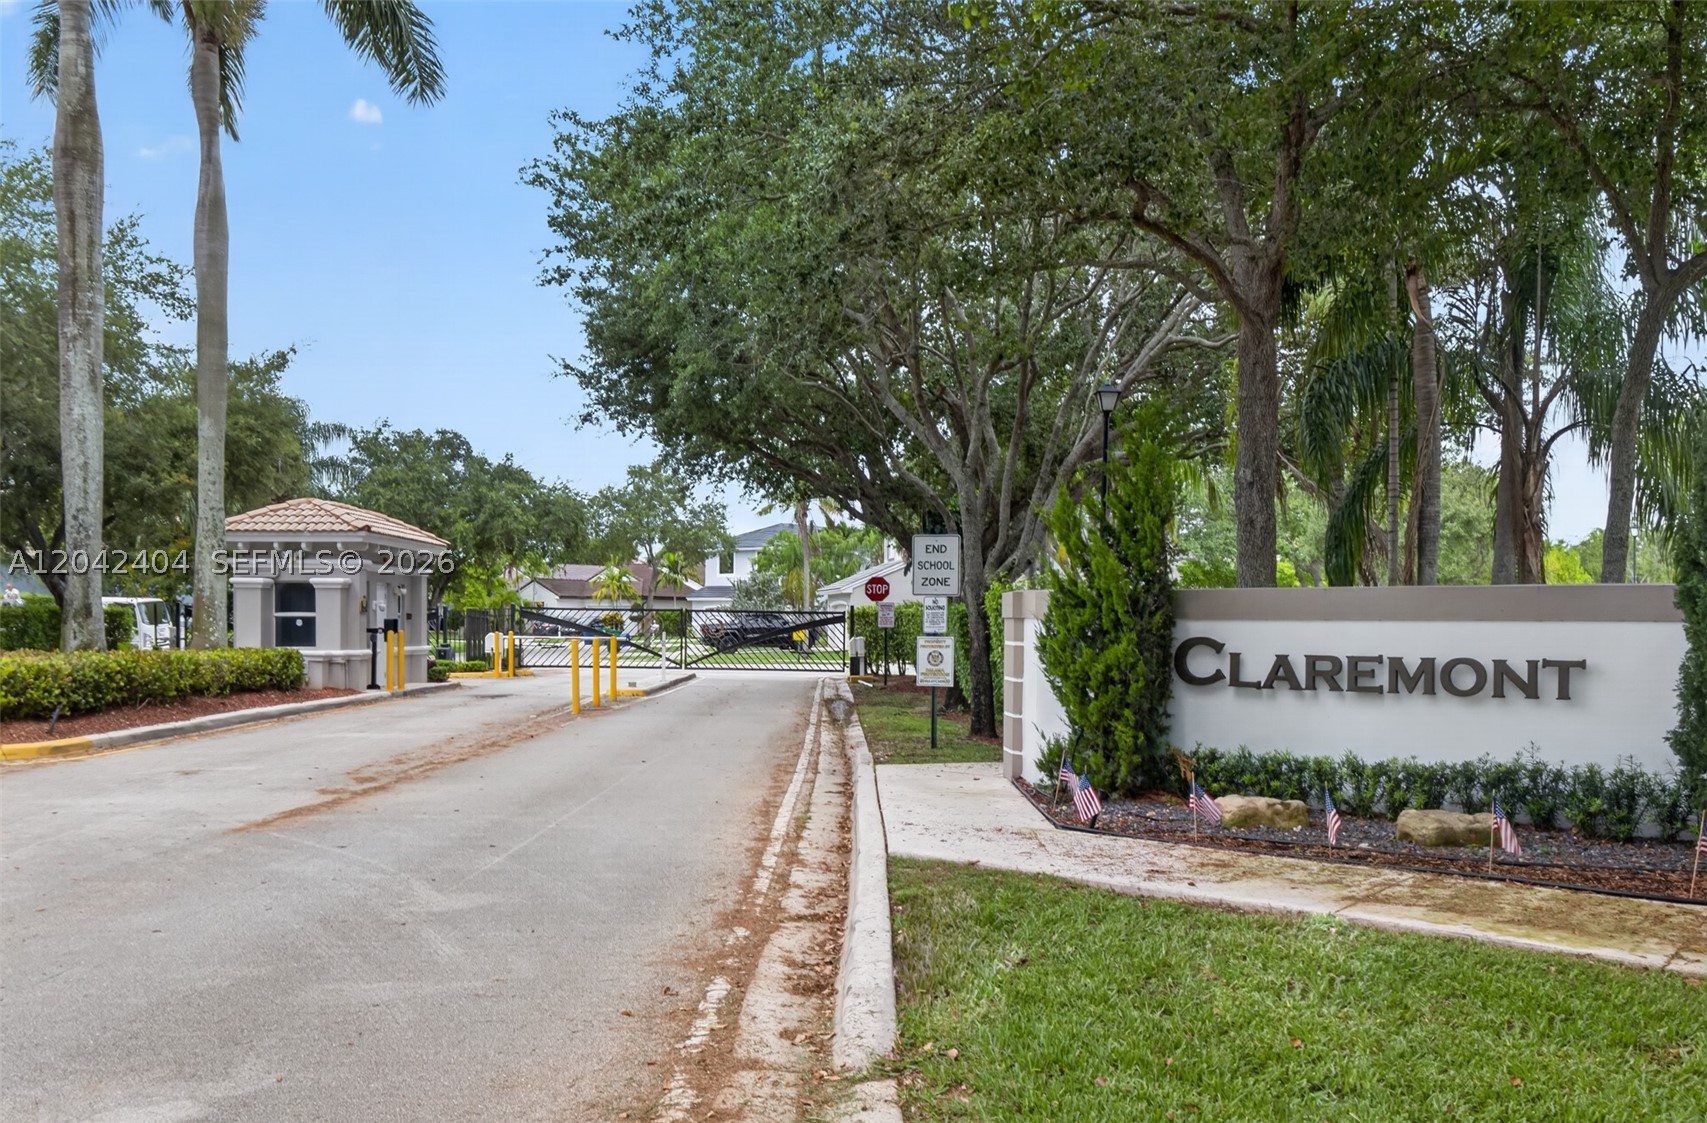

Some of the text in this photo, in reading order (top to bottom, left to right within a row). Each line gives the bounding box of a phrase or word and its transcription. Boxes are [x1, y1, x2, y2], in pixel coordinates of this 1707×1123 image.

[925, 544, 948, 554] END
[917, 560, 955, 571] SCHOOL
[921, 577, 951, 587] ZONE
[866, 584, 889, 594] STOP
[1173, 636, 1587, 700] CLAREMONT
